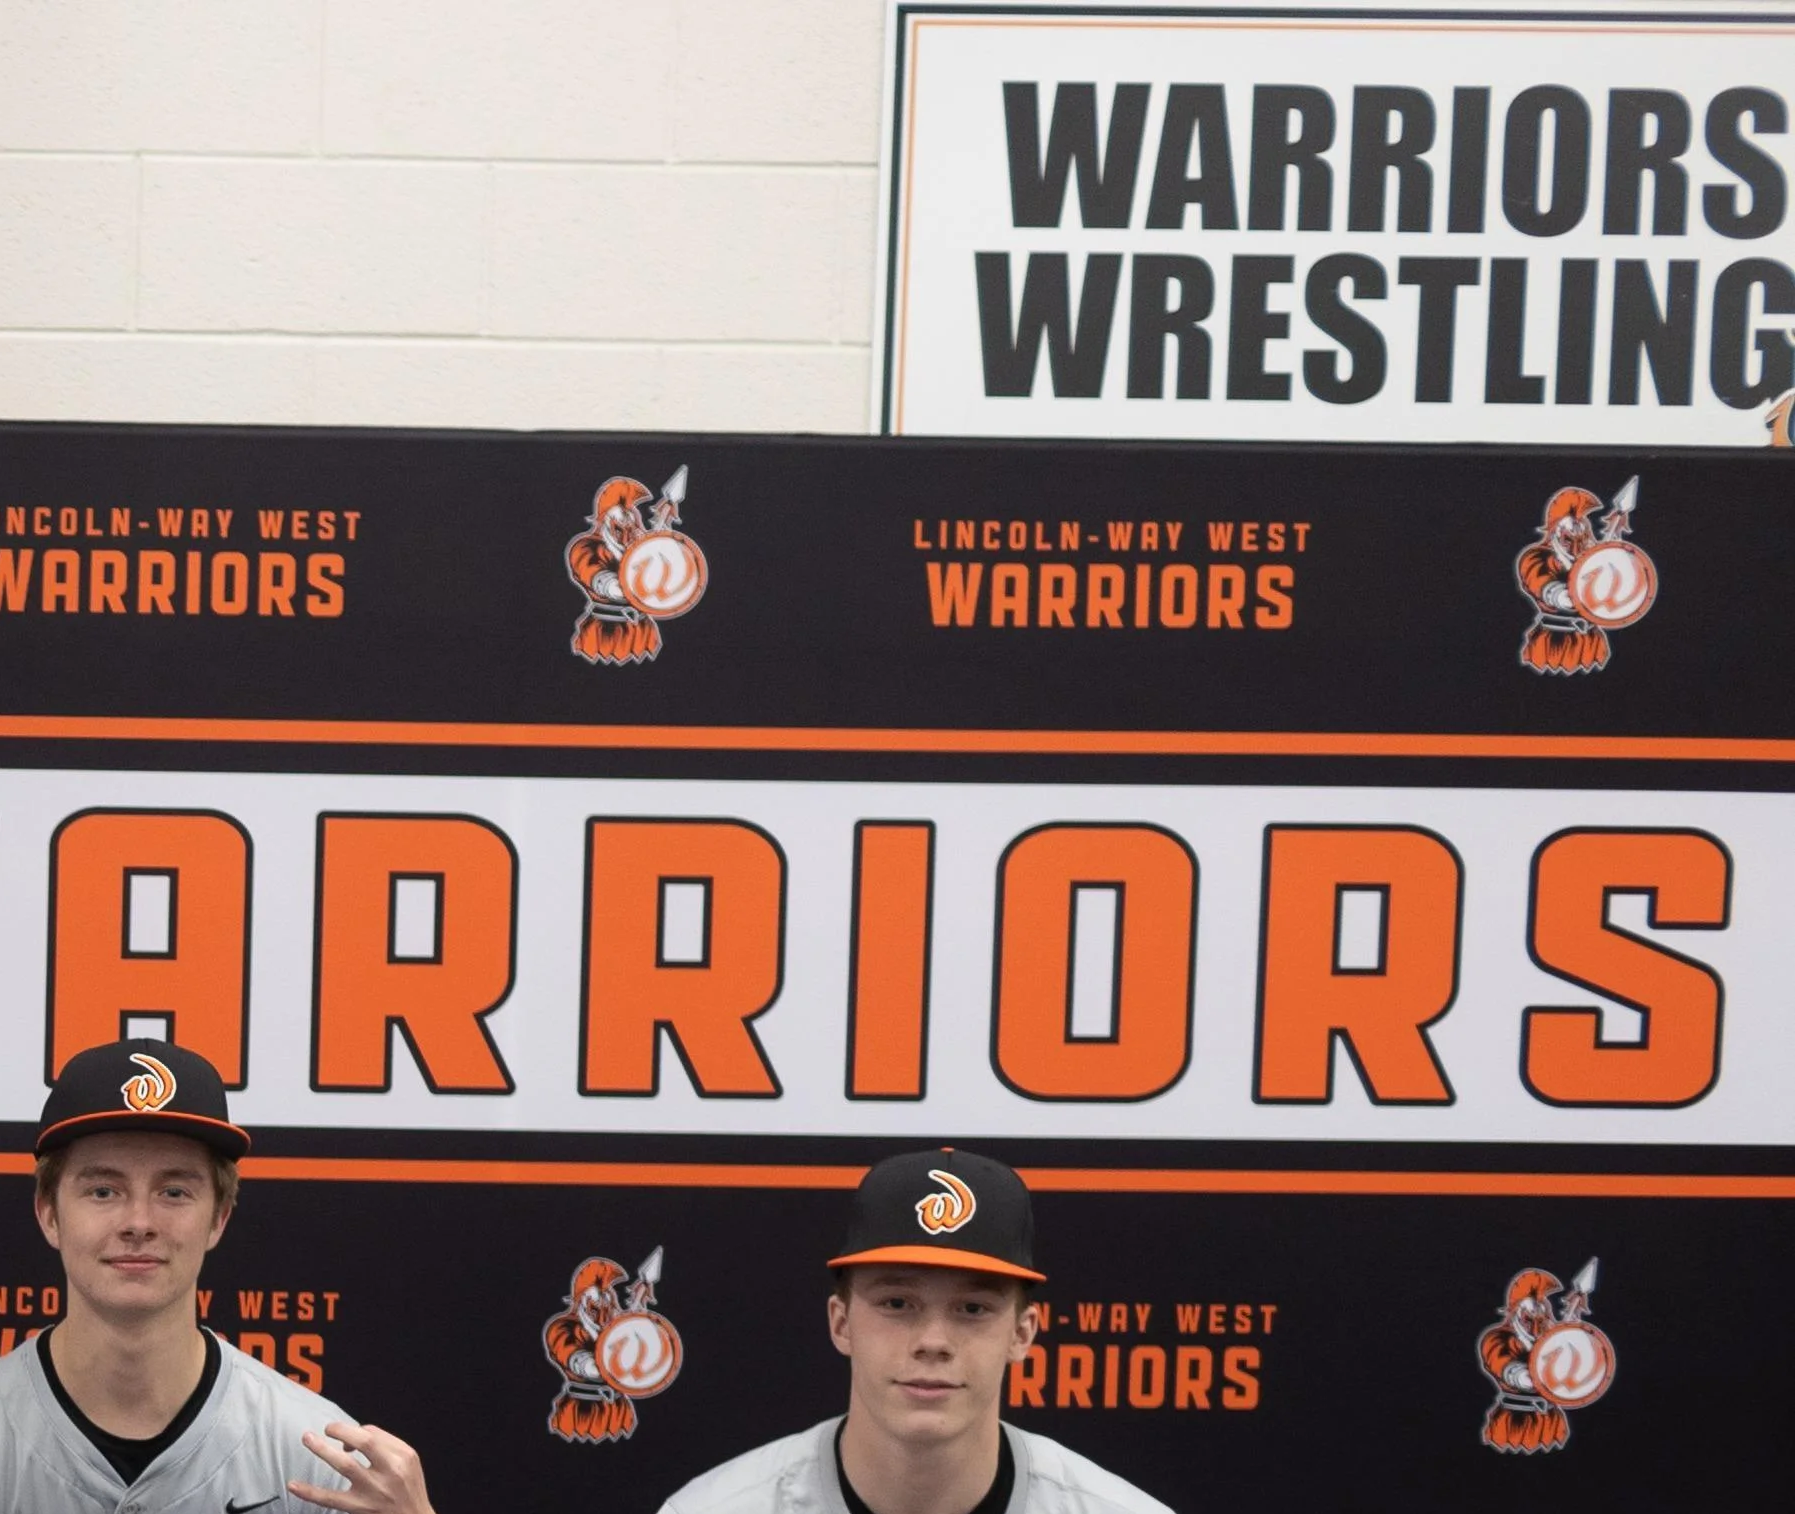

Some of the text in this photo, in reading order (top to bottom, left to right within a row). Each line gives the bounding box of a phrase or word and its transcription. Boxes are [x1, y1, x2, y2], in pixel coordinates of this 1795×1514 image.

[1001, 81, 1789, 239] WARRIORS
[974, 251, 1795, 410] WRESTLING
[259, 511, 360, 540] WEST
[914, 521, 1309, 552] LINCOLN-WAY WEST
[926, 563, 1294, 630] WARRIORS
[238, 1290, 339, 1321] WEST
[1176, 1304, 1277, 1334] WEST
[1007, 1338, 1261, 1410] RRIORS
